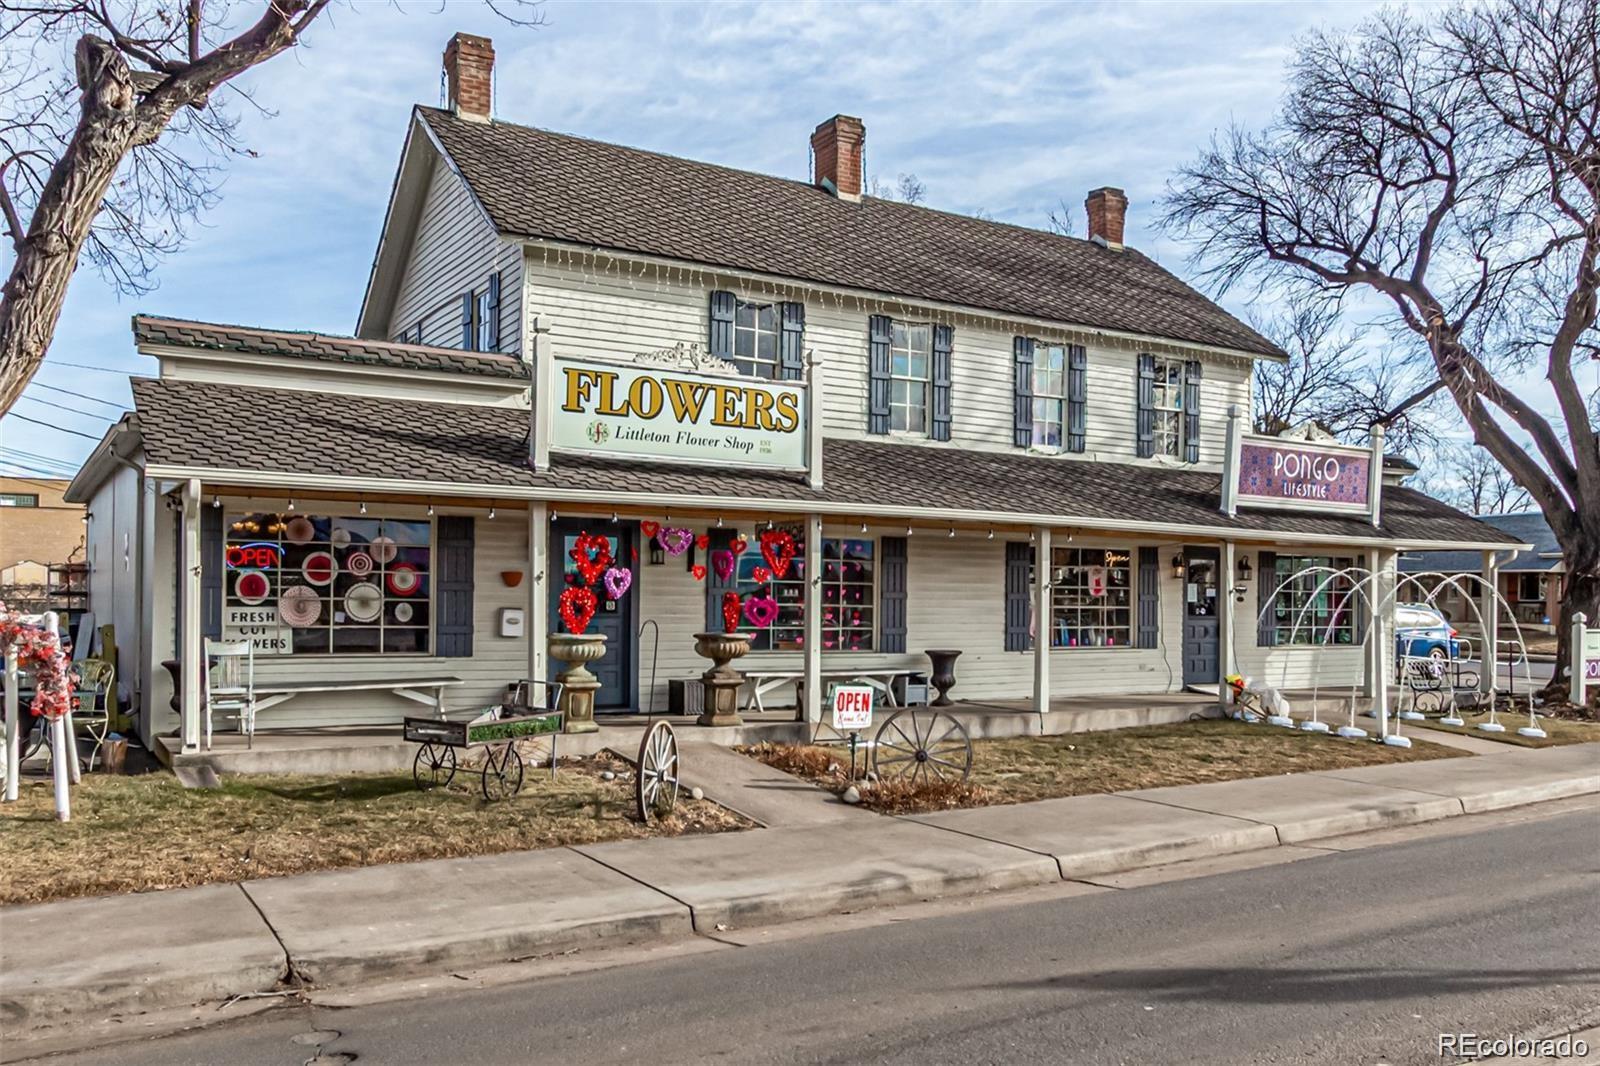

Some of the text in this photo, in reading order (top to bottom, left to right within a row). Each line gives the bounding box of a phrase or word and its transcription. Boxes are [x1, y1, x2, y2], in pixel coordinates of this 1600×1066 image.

[562, 367, 799, 434] FLOWERS
[615, 426, 754, 454] Littleton Flower Shop
[1274, 452, 1340, 481] PONGO
[226, 548, 279, 566] OPEN
[231, 612, 275, 623] FRESH
[837, 693, 870, 712] OPEN
